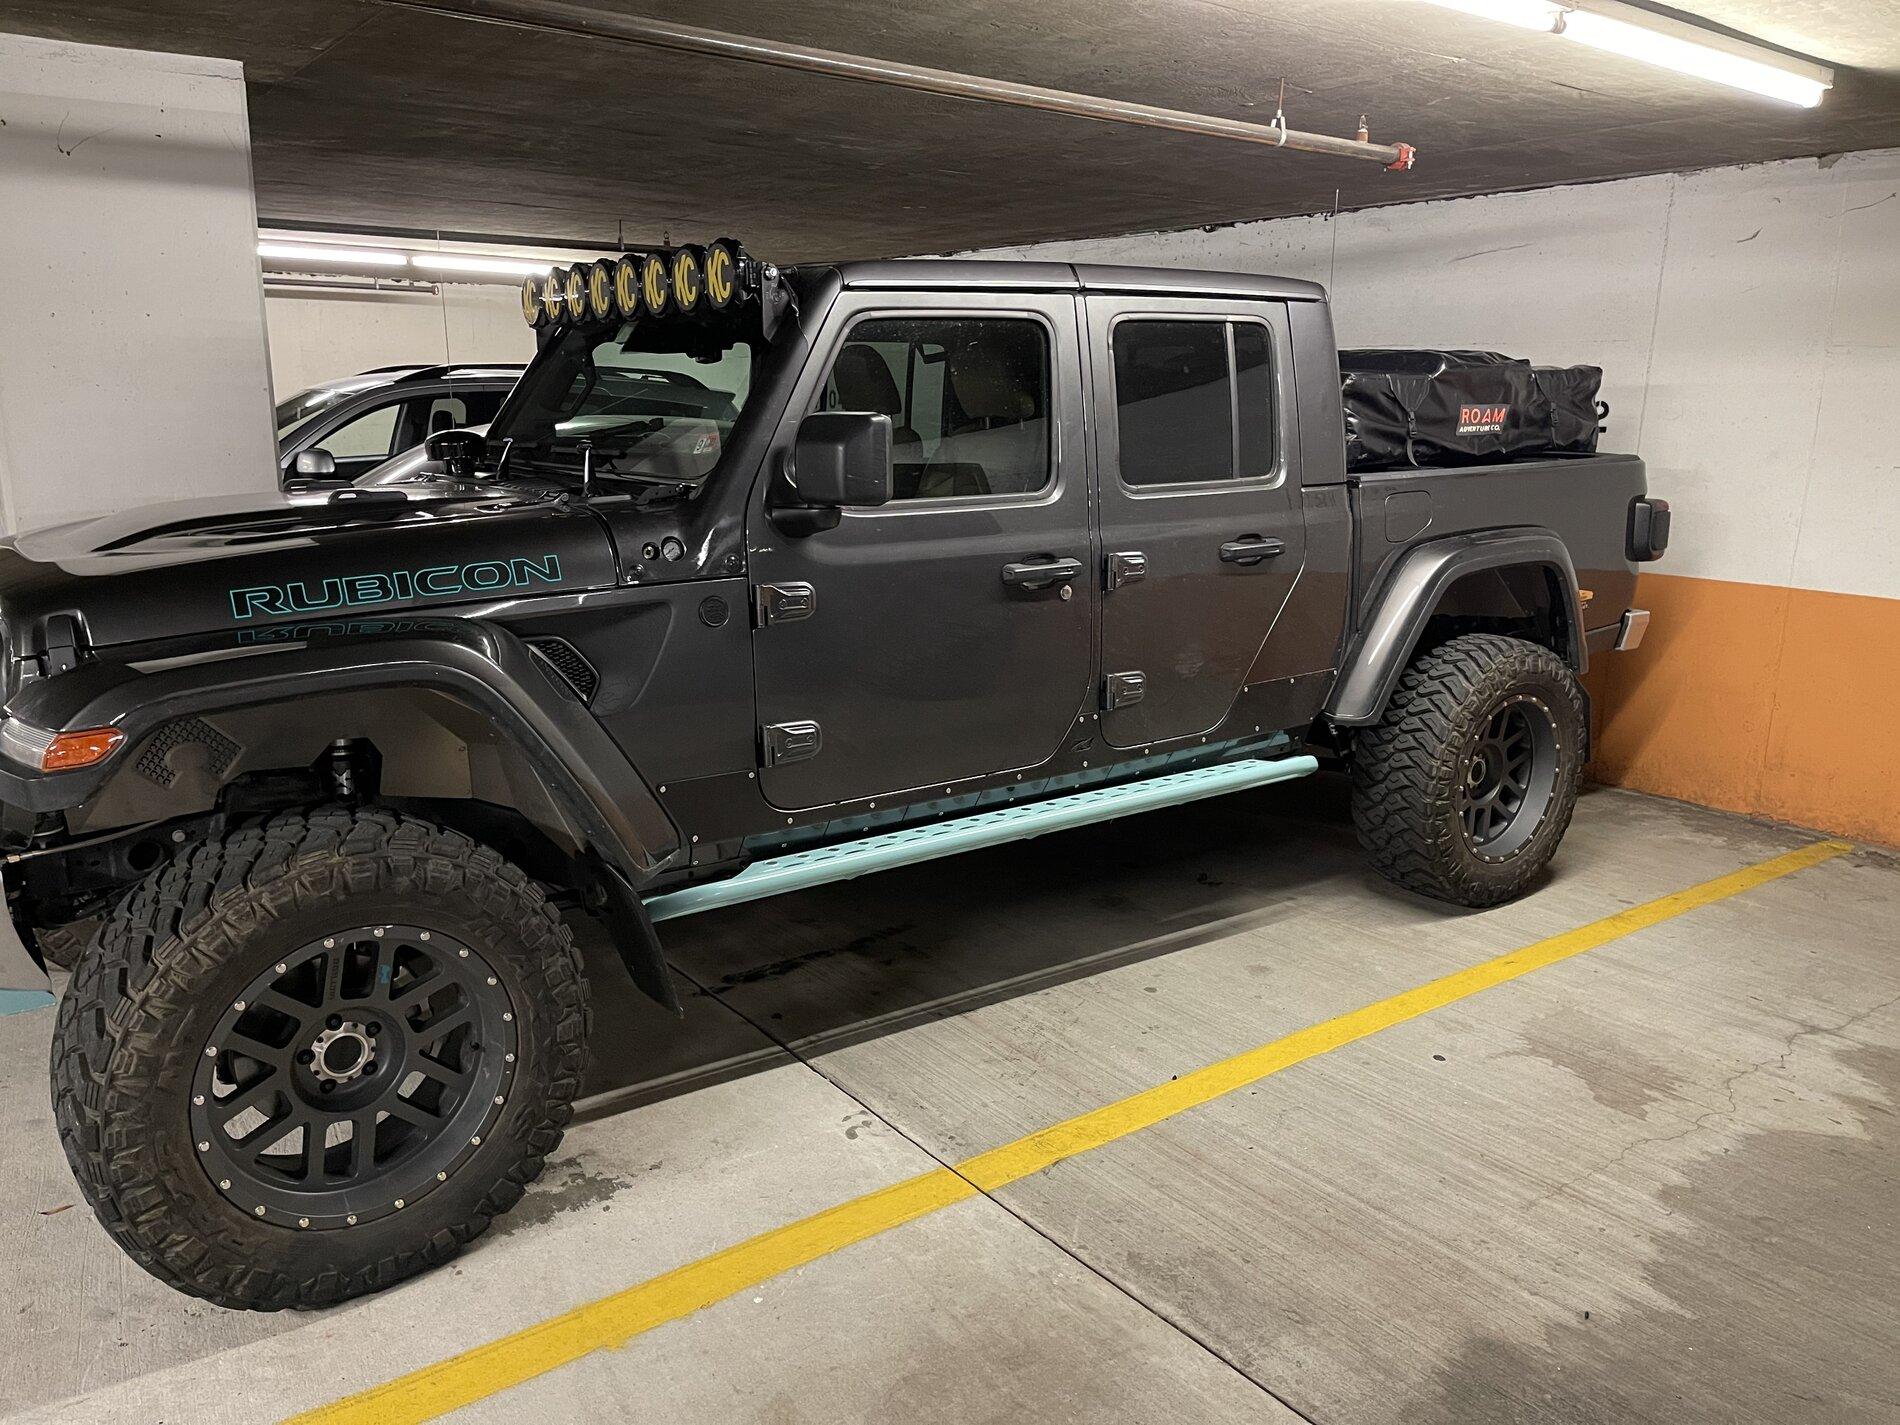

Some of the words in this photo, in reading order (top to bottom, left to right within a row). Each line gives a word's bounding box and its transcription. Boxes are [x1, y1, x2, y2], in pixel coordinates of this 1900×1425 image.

[544, 275, 560, 319] KC
[566, 271, 583, 317] KC
[590, 267, 608, 314] KC
[616, 264, 635, 312] KC
[644, 259, 665, 309] KC
[674, 254, 696, 306] KC
[707, 248, 731, 303] KC
[1461, 407, 1506, 424] ROAM
[229, 554, 562, 619] RUBICON
